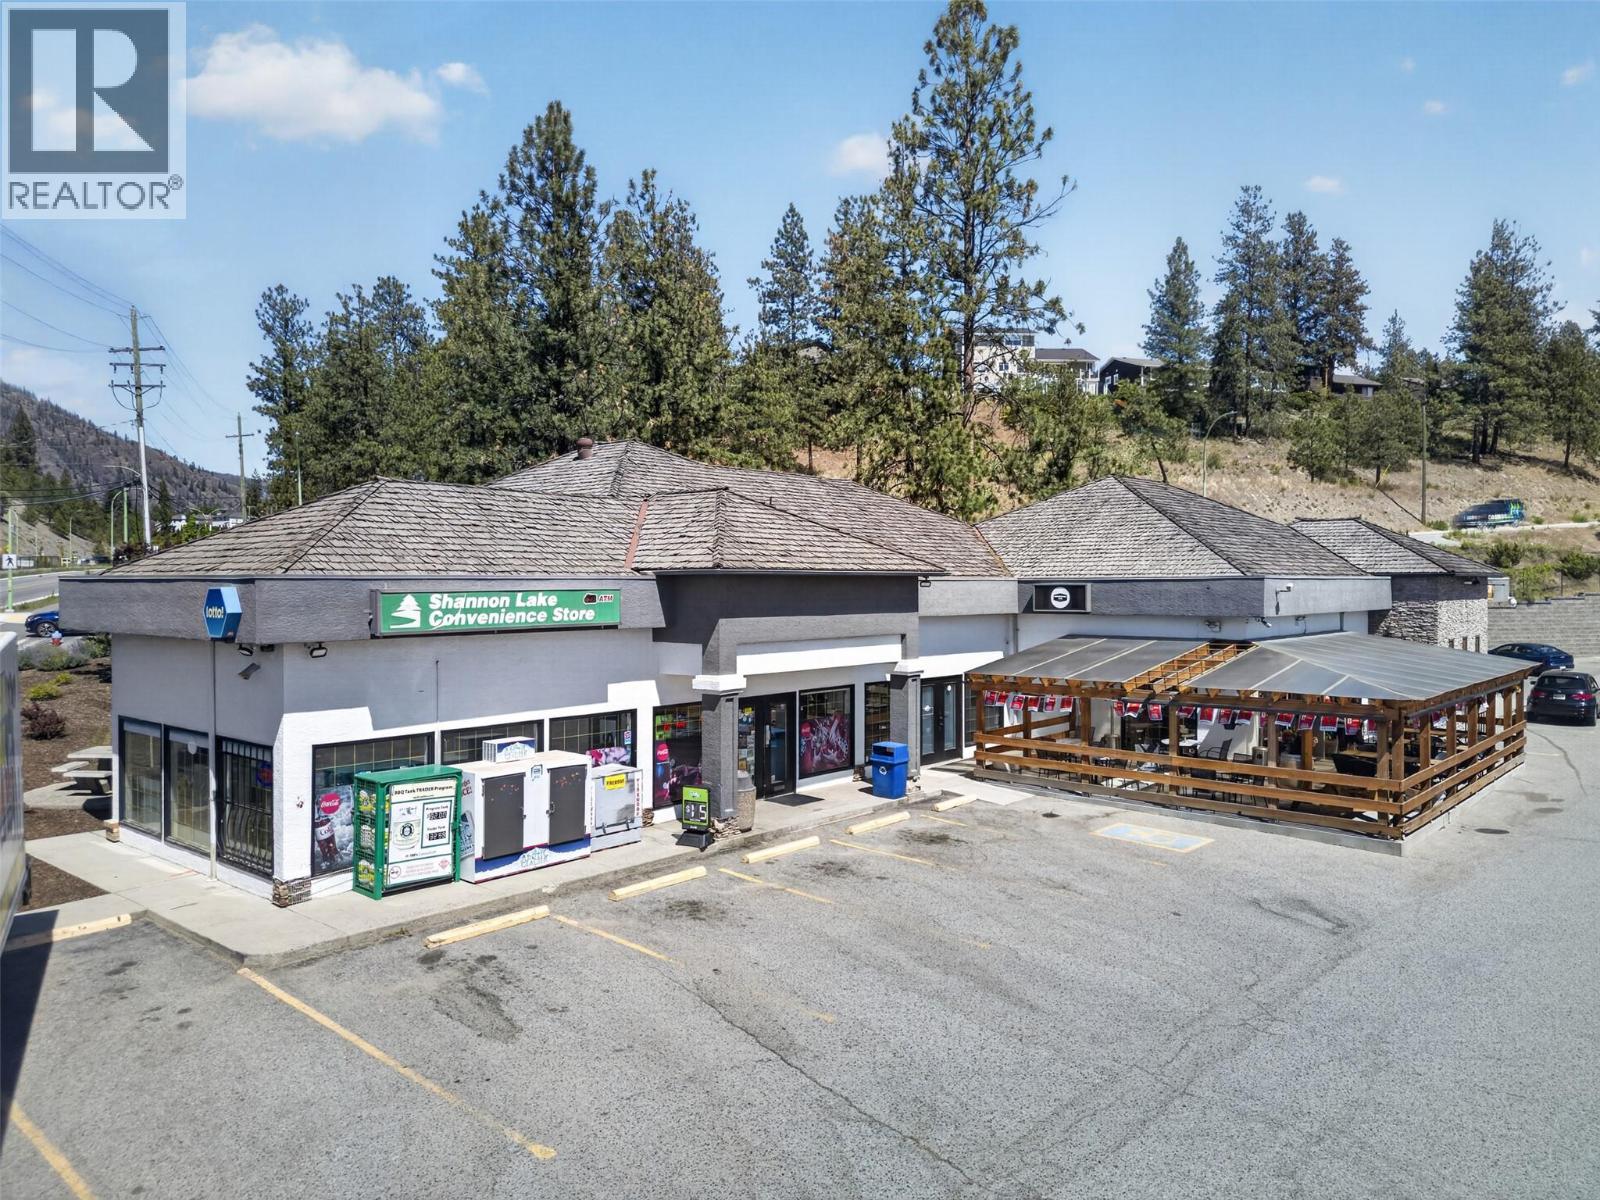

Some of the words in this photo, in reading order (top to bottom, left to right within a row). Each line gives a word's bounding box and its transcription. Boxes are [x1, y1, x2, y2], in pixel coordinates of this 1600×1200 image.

[429, 593, 510, 609] Shannon
[517, 592, 558, 607] Lake
[598, 594, 613, 602] ATM
[206, 605, 224, 619] lotto!
[429, 609, 547, 626] Convenience
[553, 608, 595, 621] Store
